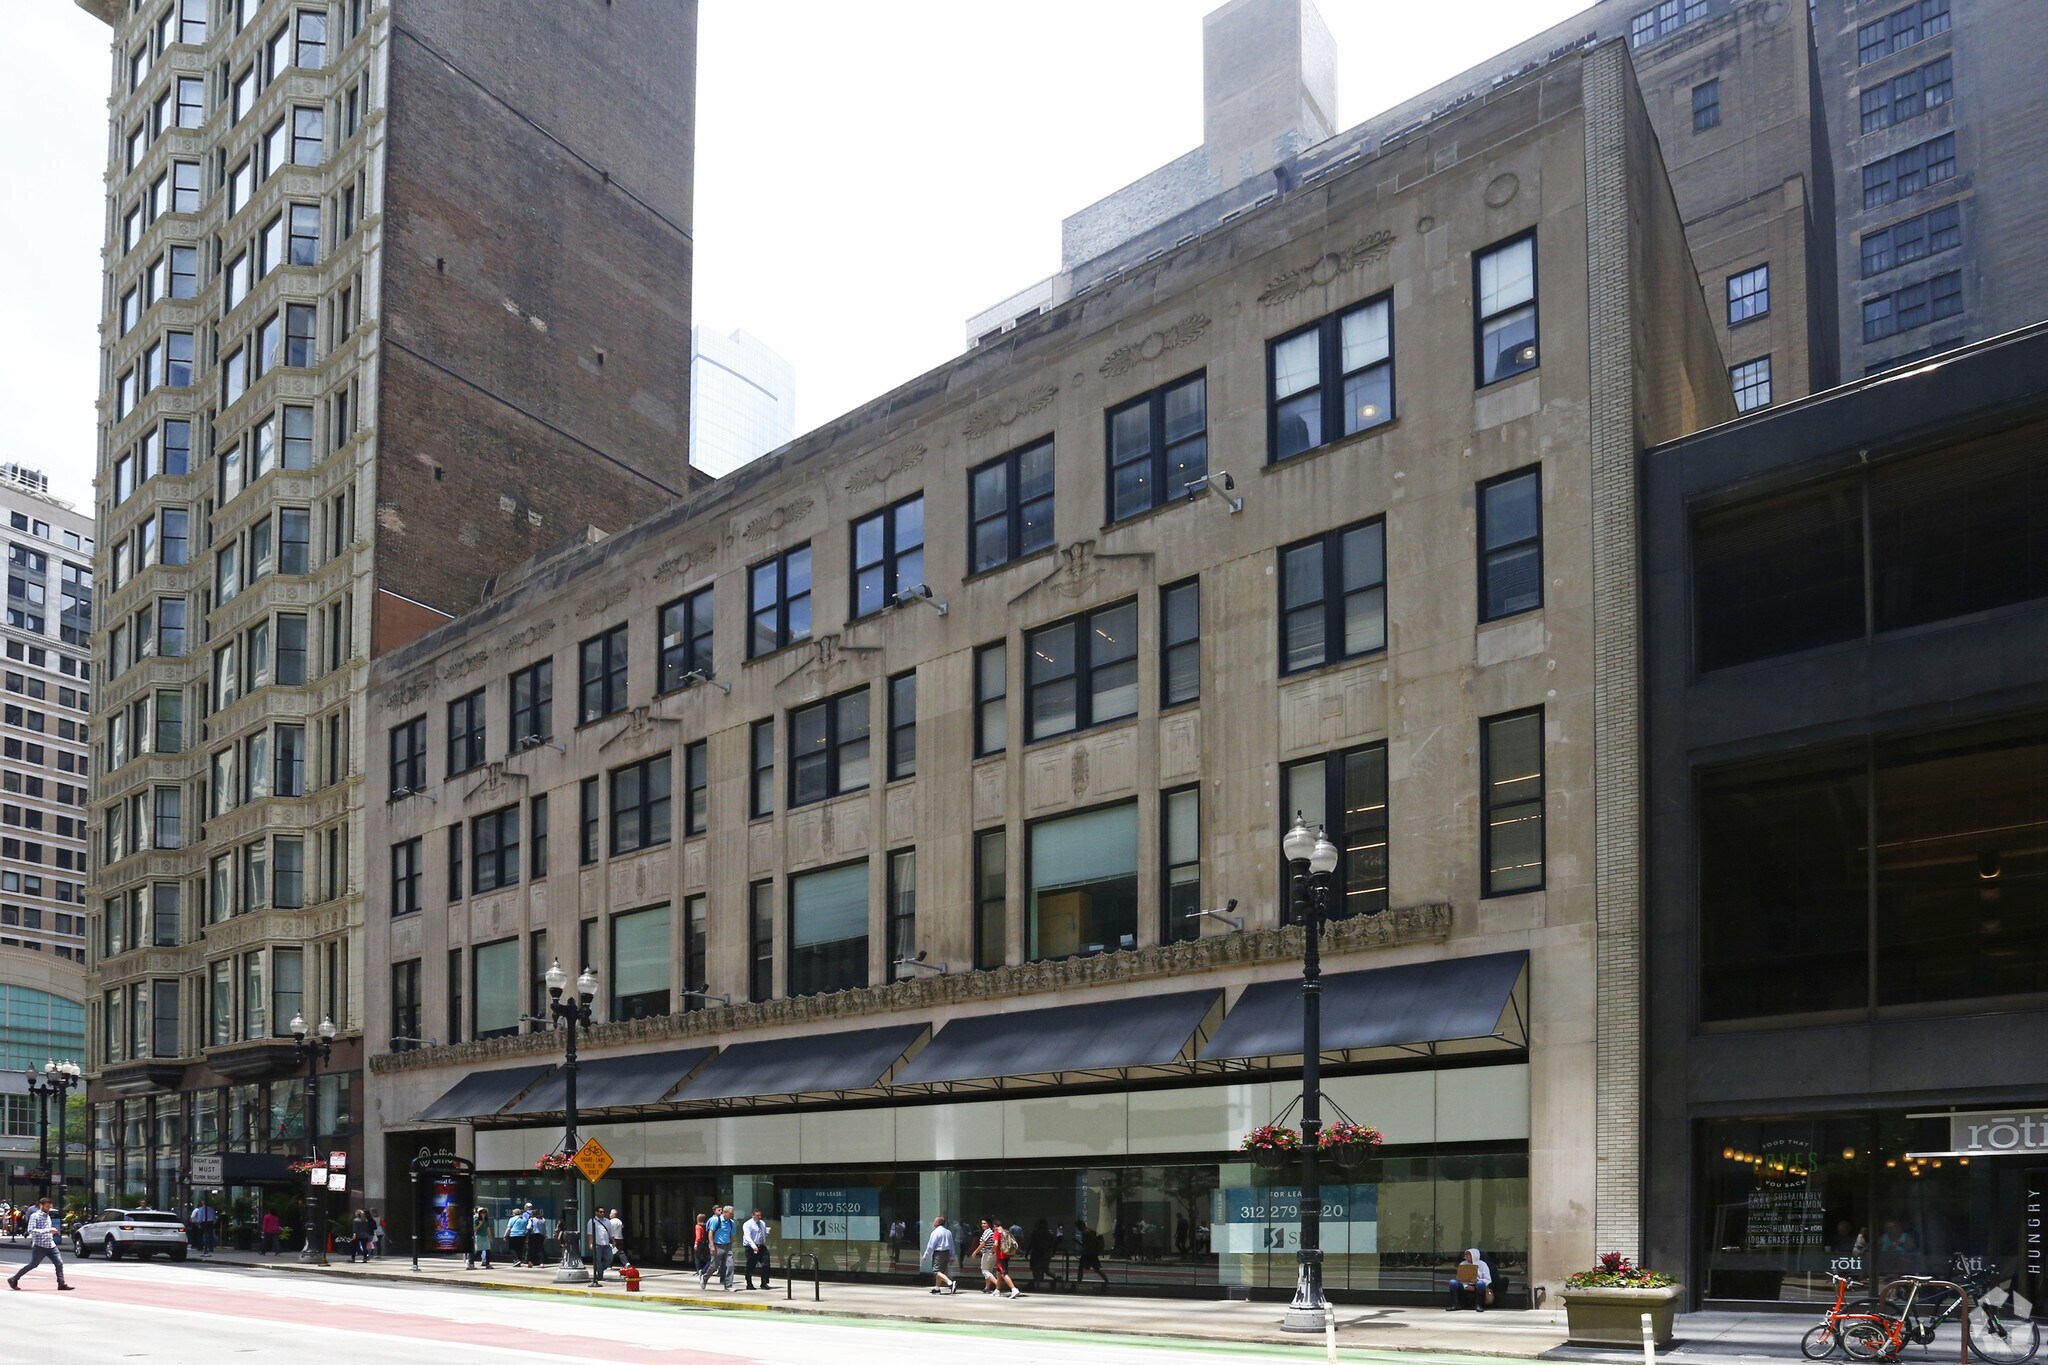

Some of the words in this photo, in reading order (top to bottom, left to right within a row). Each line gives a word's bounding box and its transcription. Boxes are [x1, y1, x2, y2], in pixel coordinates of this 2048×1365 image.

[1763, 1140, 1785, 1149] FOOD
[1788, 1140, 1809, 1148] THAT
[432, 1148, 458, 1164] offic
[1753, 1152, 1818, 1175] LOVES
[1765, 1180, 1781, 1188] YOU
[1785, 1180, 1806, 1188] BACK
[1287, 1190, 1303, 1198] LEA
[1773, 1191, 1822, 1200] SUSTAINABLY
[799, 1202, 814, 1213] 312
[816, 1202, 833, 1213] 279
[1794, 1200, 1822, 1209] SALMON
[1240, 1206, 1265, 1219] 312
[1270, 1205, 1297, 1218] 279
[828, 1223, 847, 1234] SRS
[1772, 1224, 1804, 1233] HUMMUS
[2028, 1189, 2041, 1274] HUNGRY
[1747, 1235, 1766, 1245] 100%
[1807, 1235, 1823, 1244] BEEF
[1830, 1256, 1862, 1270] rōti
